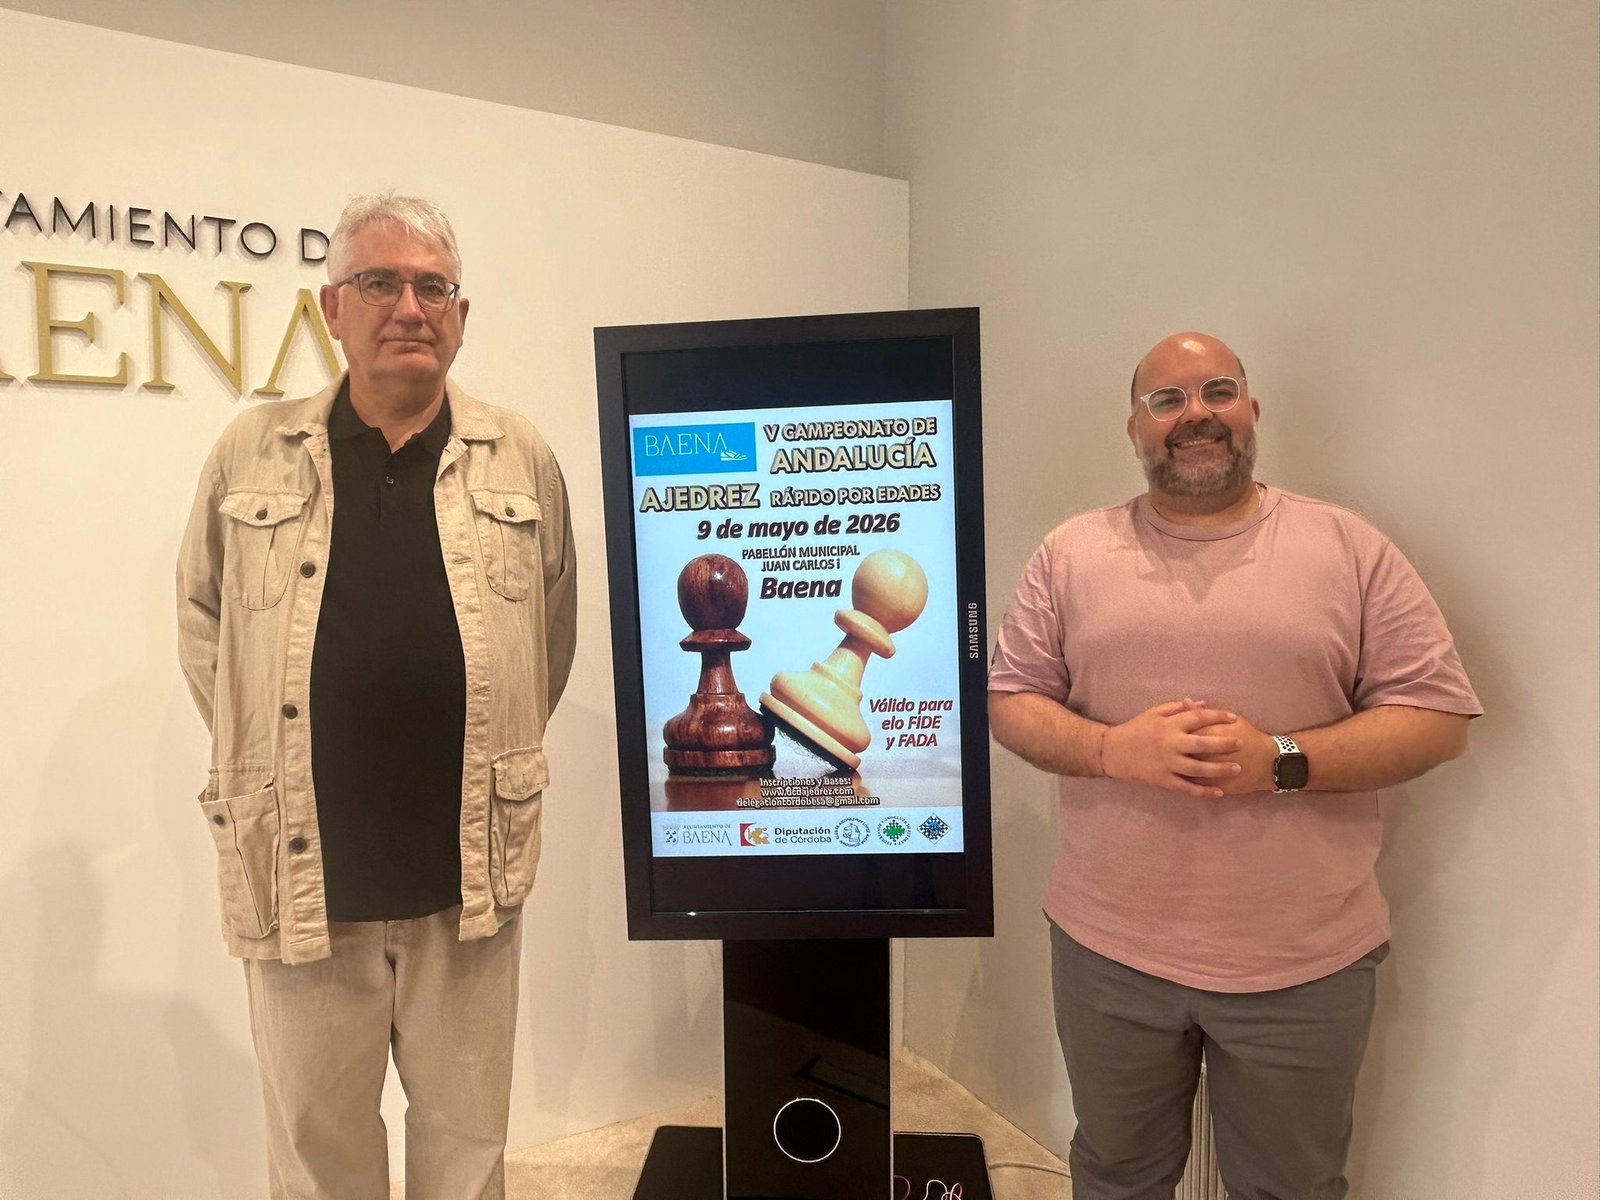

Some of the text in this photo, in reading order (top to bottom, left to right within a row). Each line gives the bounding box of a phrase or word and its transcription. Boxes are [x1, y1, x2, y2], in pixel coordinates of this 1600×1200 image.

[0, 191, 330, 262] AMIENTO D
[0, 260, 343, 399] ENA
[763, 417, 937, 442] V CAMPEONATO DE
[644, 432, 729, 457] BAENA
[770, 437, 937, 473] ANDALUCÍA
[640, 483, 760, 512] AJEDREZ
[770, 485, 941, 507] RÁPIDO POR EDADES
[697, 512, 901, 541] 9 de mayo de 2026
[741, 545, 860, 560] PABELLÓN MUNICIPAL
[760, 560, 790, 572] JUAN
[792, 559, 833, 571] CARLOS
[760, 577, 842, 600] Baena
[968, 602, 979, 659] SAMSUNG
[869, 698, 953, 714] Válido para
[882, 715, 942, 730] elo FIDE
[886, 733, 938, 750] y FADA
[760, 777, 852, 788] Inscripciones y Bases:
[683, 830, 732, 846] BAENA
[774, 827, 831, 837] Diputación
[775, 836, 787, 844] de
[789, 835, 832, 844] Córdoba
